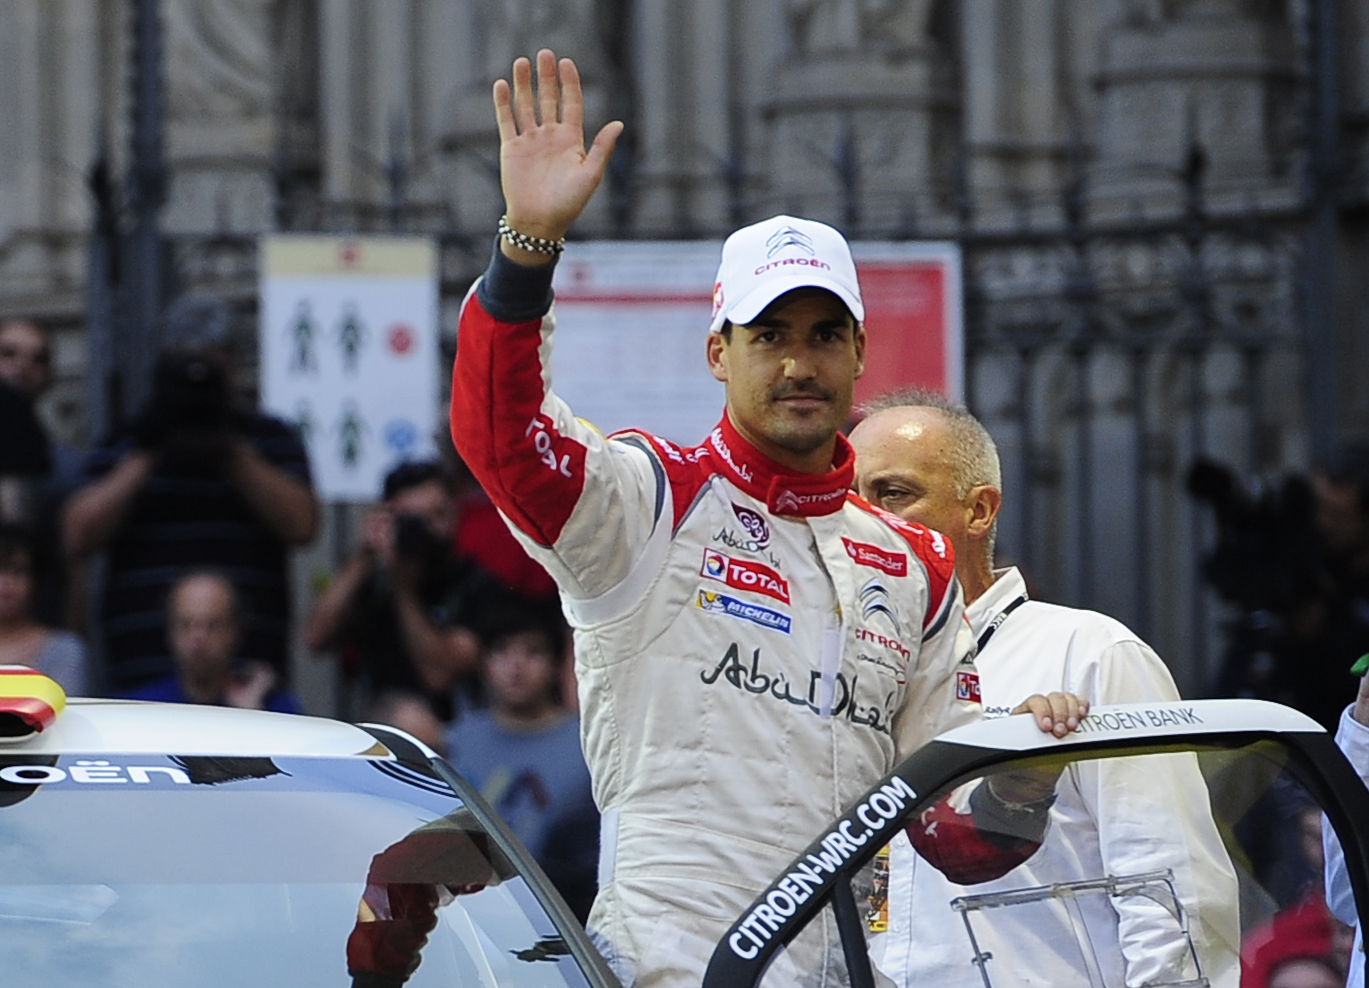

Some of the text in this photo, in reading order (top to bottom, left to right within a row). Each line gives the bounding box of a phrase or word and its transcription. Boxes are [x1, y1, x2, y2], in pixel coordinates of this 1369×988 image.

[858, 548, 904, 571] Santander
[730, 564, 789, 599] TOTAL
[728, 602, 790, 630] MICHELIN
[1145, 707, 1204, 728] BANK
[729, 776, 918, 962] CITROEN-WRC.COM
